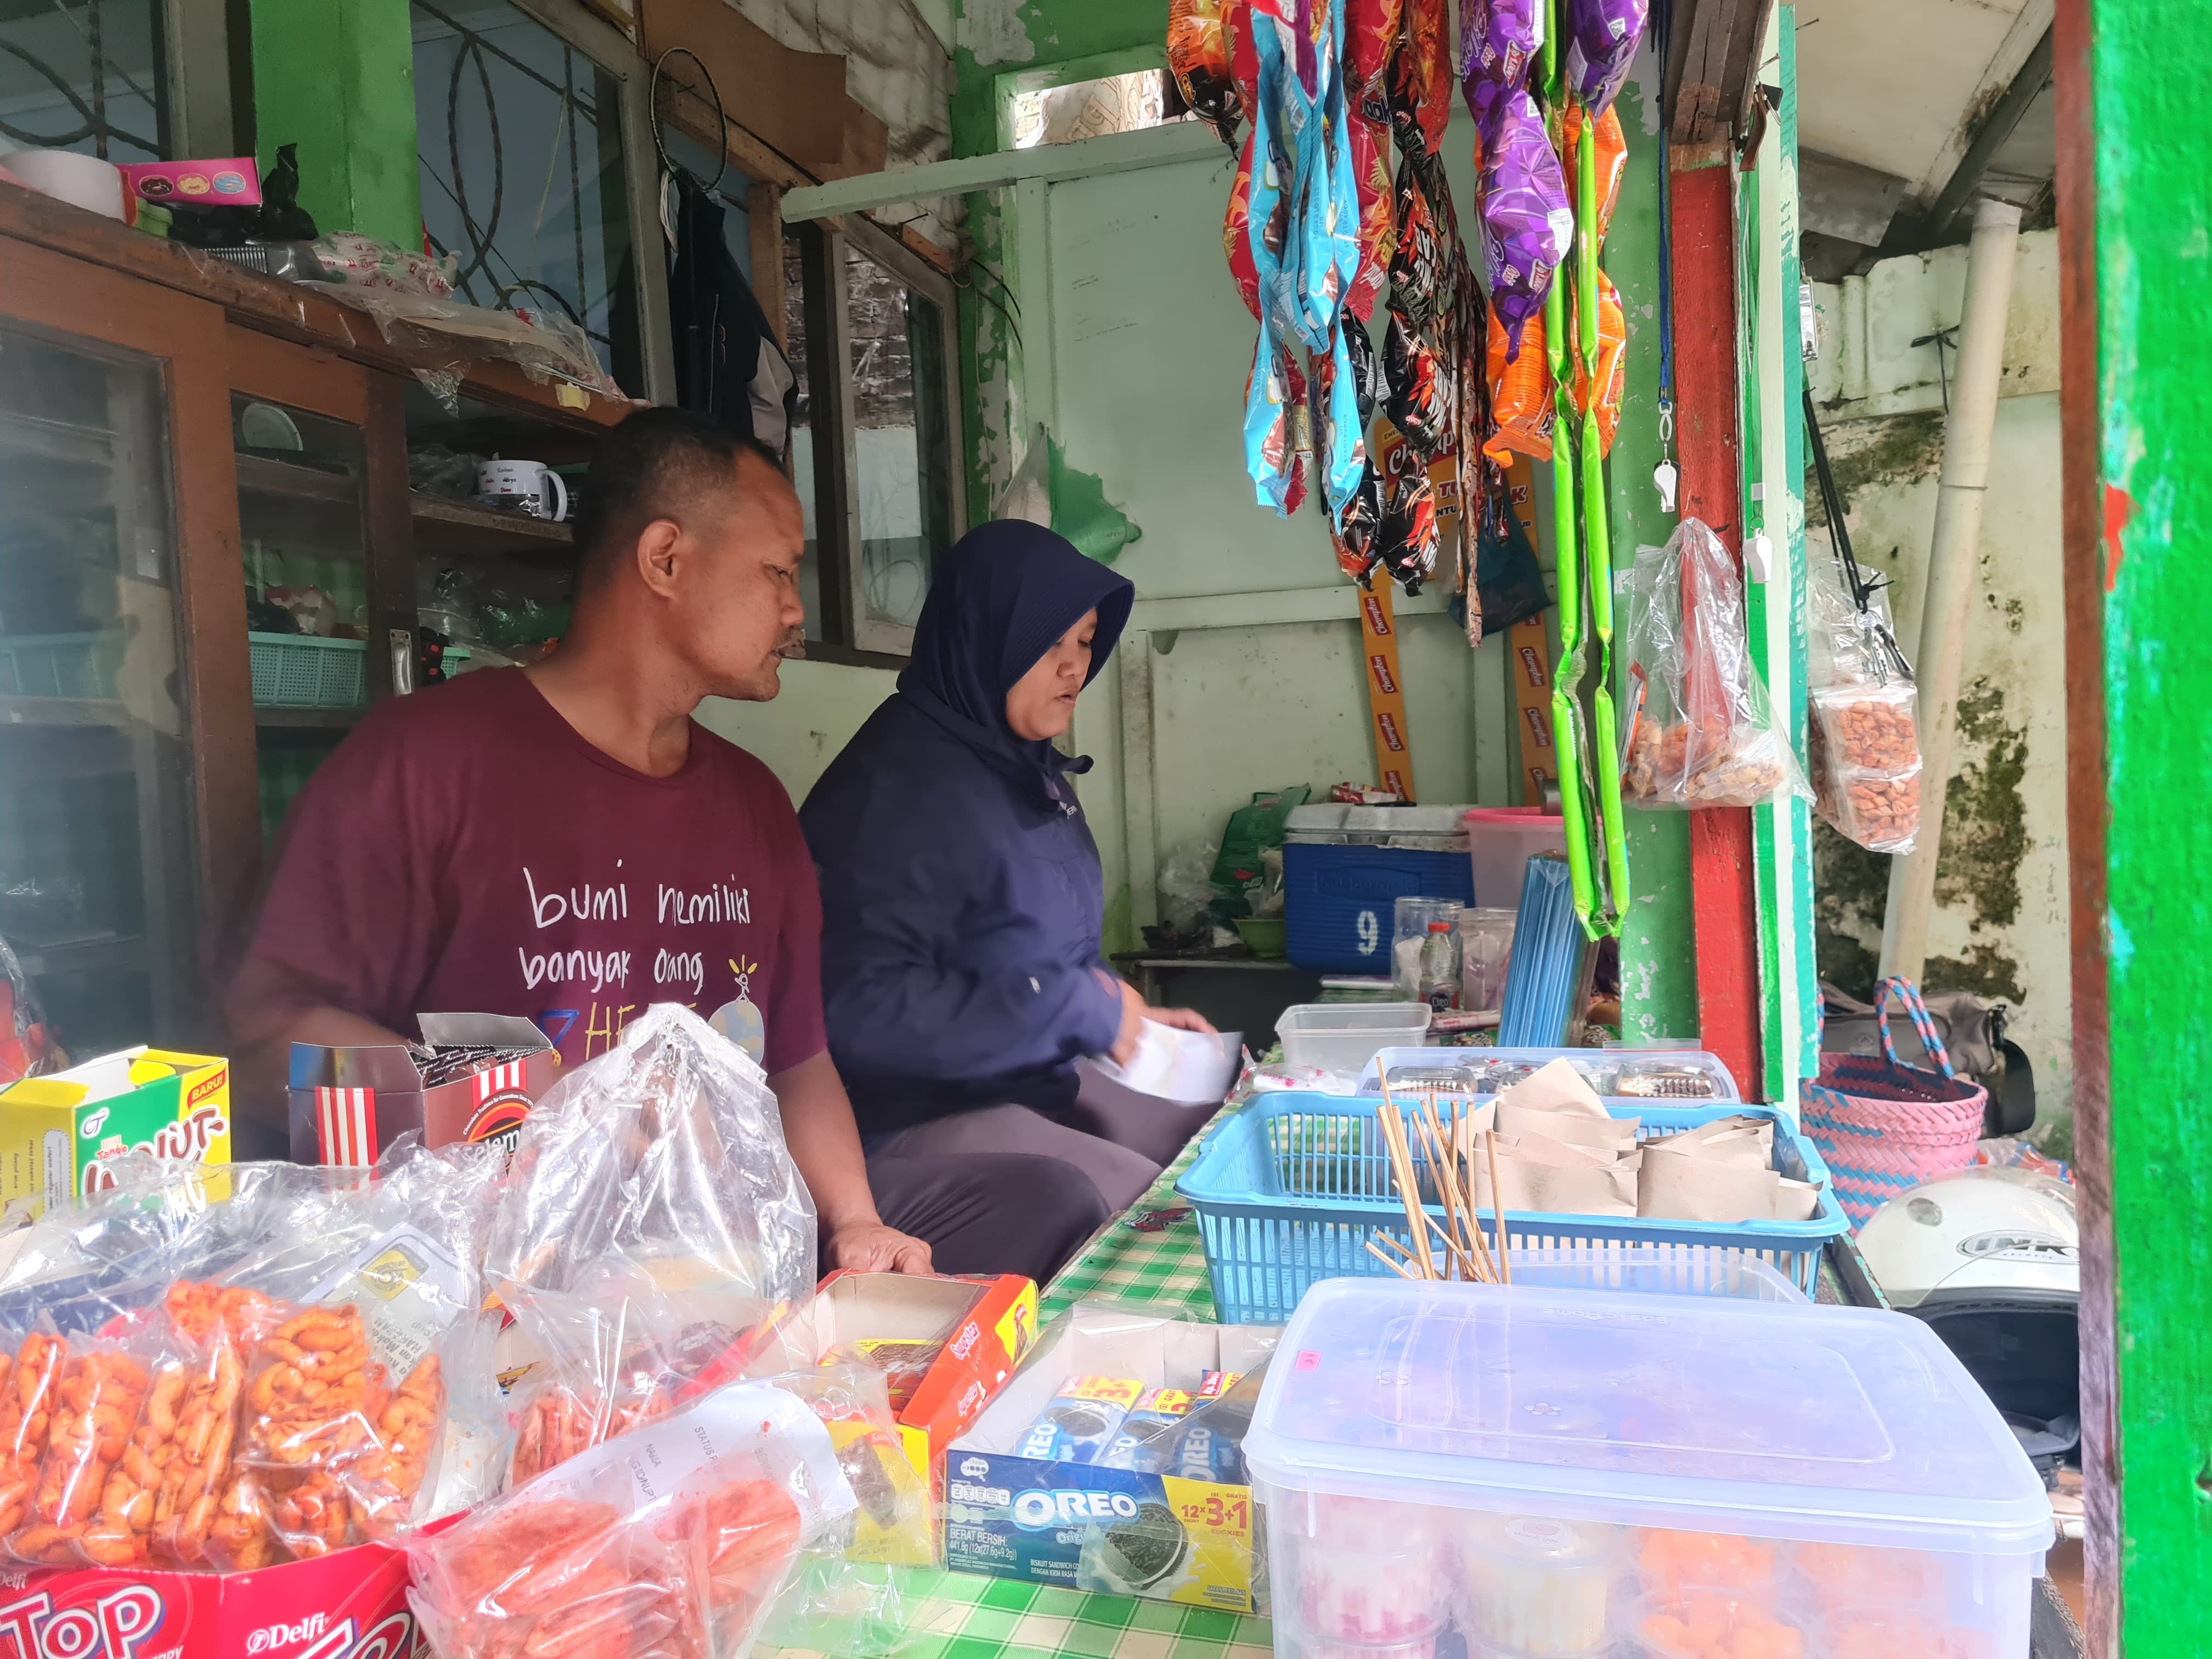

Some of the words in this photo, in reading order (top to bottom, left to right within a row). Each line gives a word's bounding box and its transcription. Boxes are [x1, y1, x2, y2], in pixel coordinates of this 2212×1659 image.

[1356, 910, 1379, 956] 9
[518, 946, 631, 994] banyak
[1432, 995, 1448, 1008] Cleo
[191, 1072, 225, 1101] BARU!
[462, 1113, 479, 1136] Chocolate
[478, 1100, 494, 1114] Tradition
[519, 1094, 528, 1102] Since
[97, 1144, 129, 1161] Tango
[950, 1321, 981, 1361] Superstar
[957, 1384, 978, 1418] Superstar
[645, 1443, 662, 1468] NAMA
[695, 1426, 716, 1456] STATUS
[1022, 1423, 1058, 1459] REO
[1015, 1492, 1138, 1527] OREO
[950, 1528, 977, 1541] BERAT
[977, 1531, 1008, 1547] BERSIH:
[950, 1539, 969, 1555] 441.6g
[1211, 1529, 1245, 1537] COOKIES
[1031, 1559, 1048, 1568] BISKUIT
[1048, 1560, 1073, 1569] SANDWICH
[1031, 1567, 1049, 1576] DENGAN
[1049, 1568, 1061, 1577] KRIM
[1061, 1569, 1074, 1578] RASA
[268, 1612, 326, 1651] Delfi
